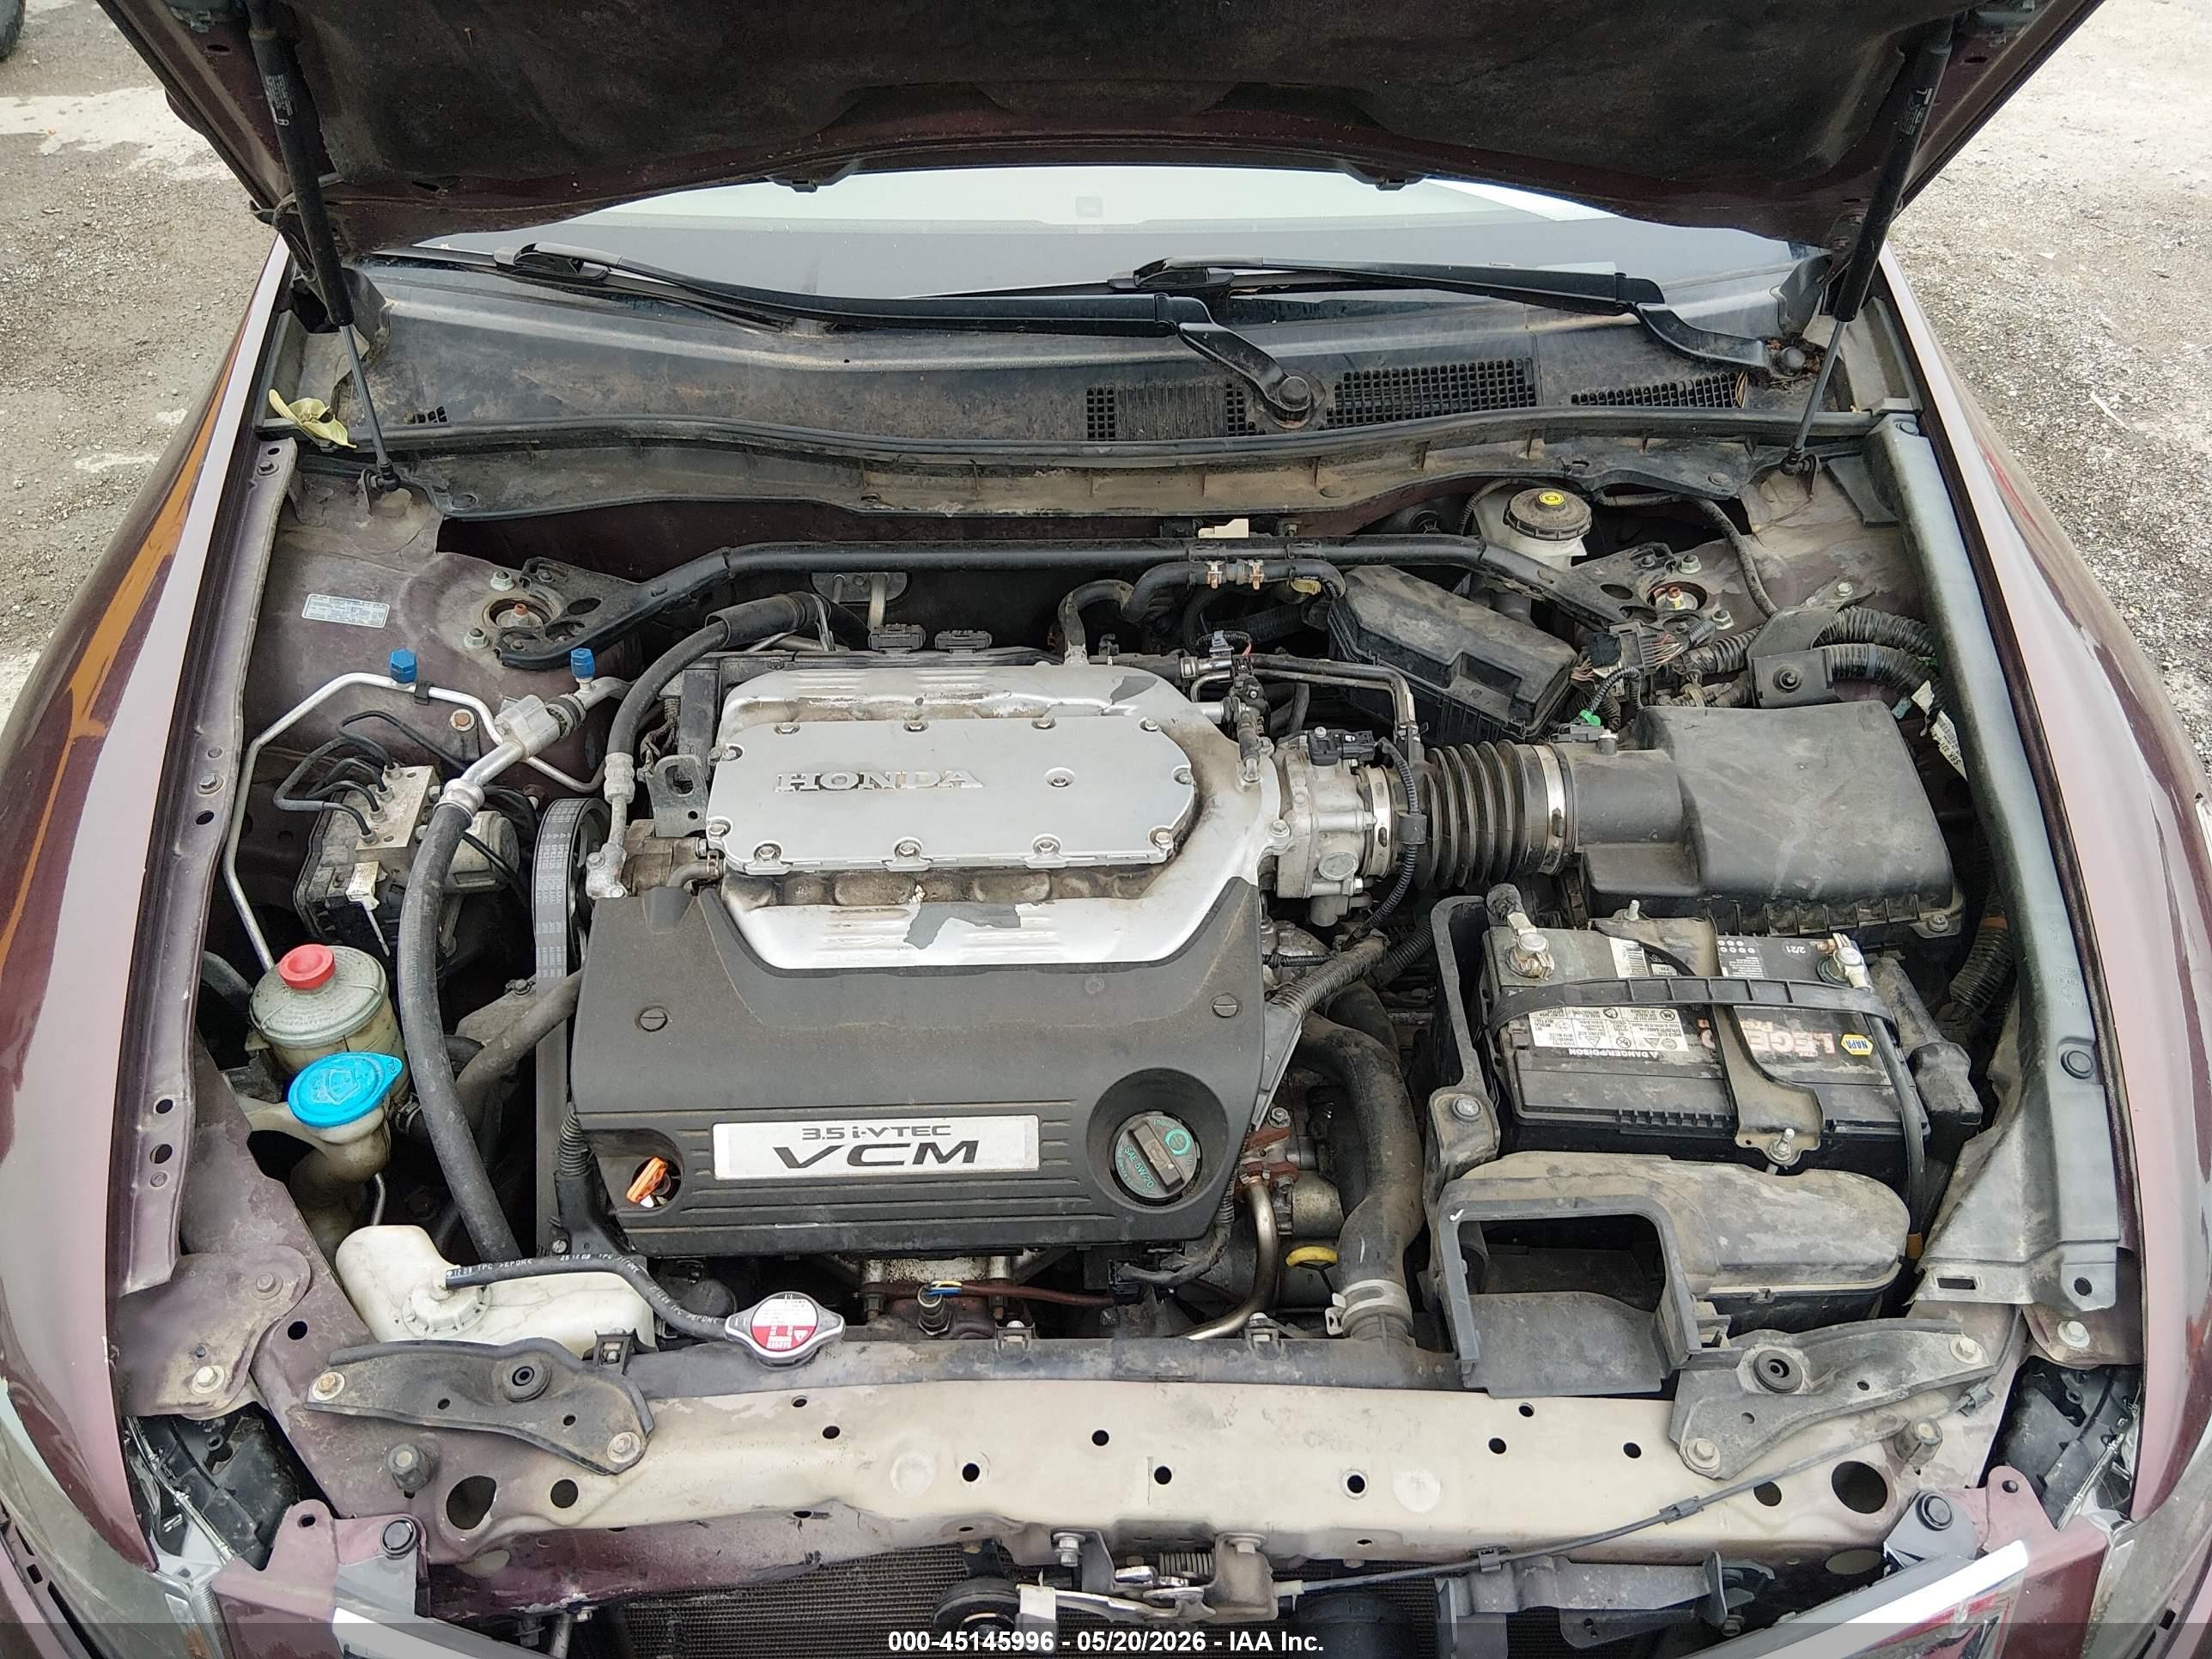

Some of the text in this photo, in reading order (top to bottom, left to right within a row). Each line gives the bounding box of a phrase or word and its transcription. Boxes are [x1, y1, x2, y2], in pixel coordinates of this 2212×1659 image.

[775, 770, 985, 793] HONDA
[1784, 943, 1807, 956] 2/21
[1845, 1039, 1869, 1050] NAPA
[1569, 1048, 1651, 1058] DANGER/POISON
[802, 1125, 951, 1140] 3.5 i-VTEC
[773, 1140, 979, 1169] VCM
[1125, 1146, 1138, 1162] SAE
[1134, 1163, 1155, 1188] 5W-20
